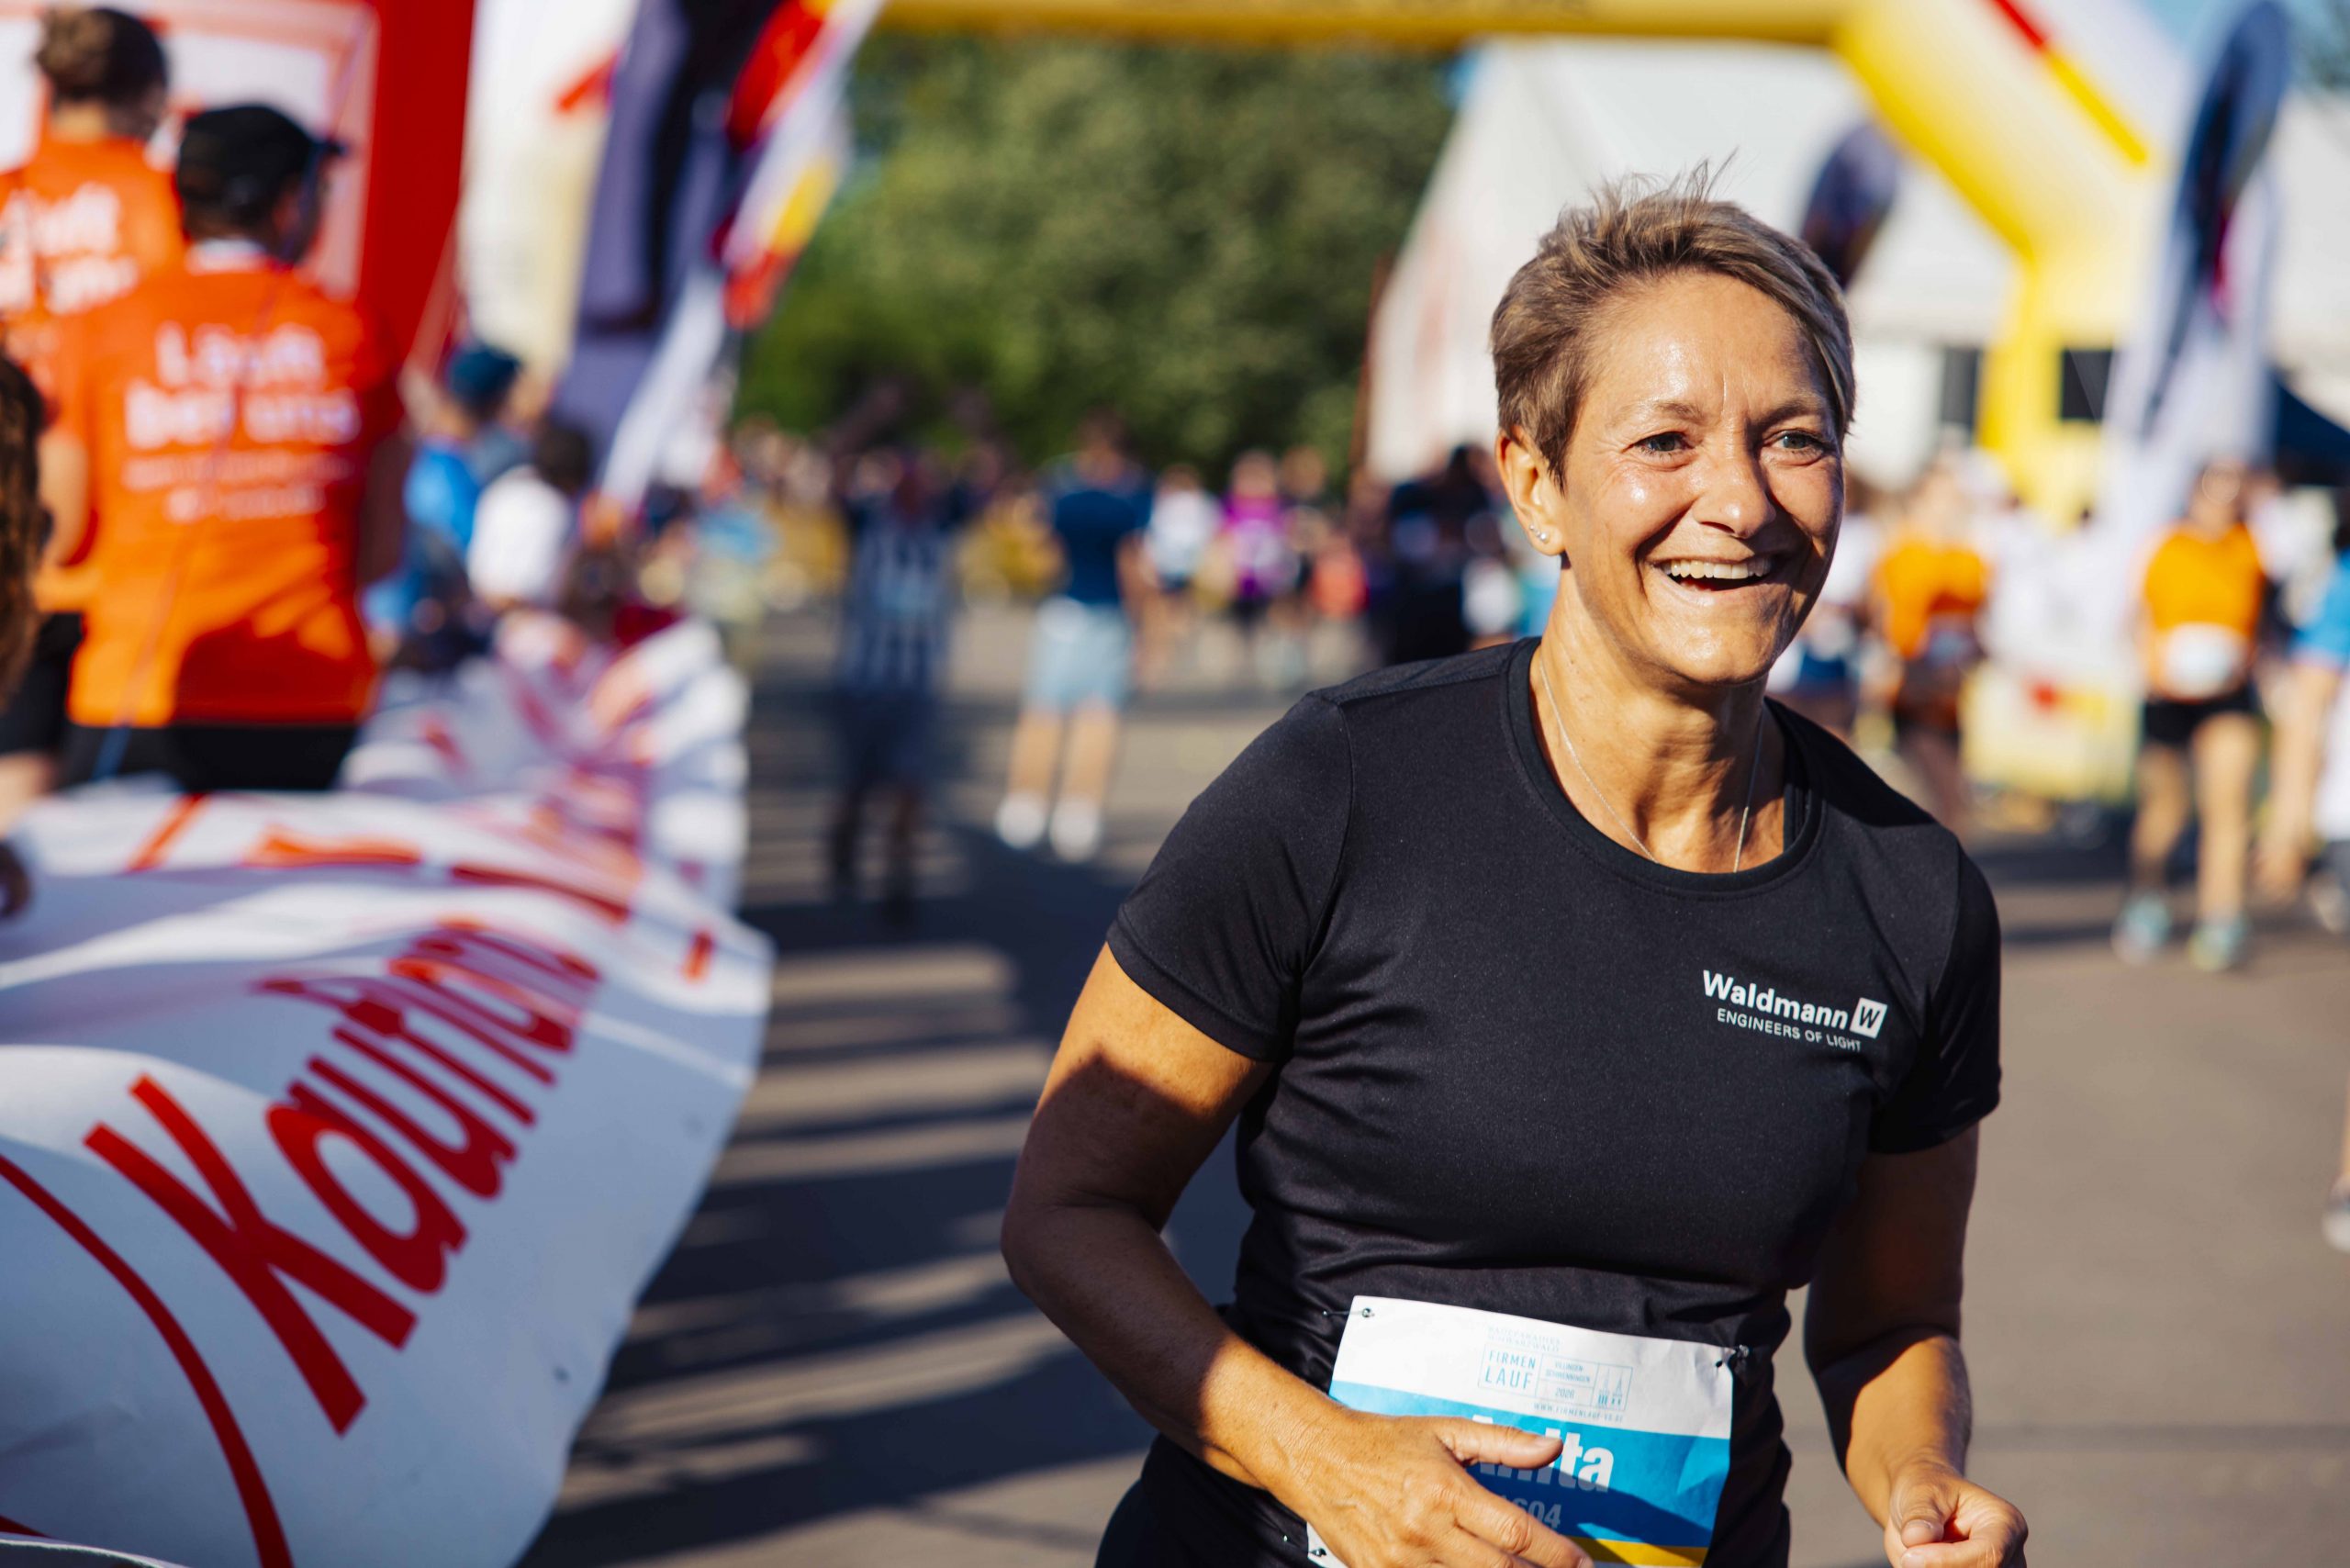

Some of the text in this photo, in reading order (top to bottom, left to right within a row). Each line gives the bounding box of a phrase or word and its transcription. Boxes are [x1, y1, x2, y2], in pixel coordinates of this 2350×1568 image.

[1703, 969, 1849, 1030] Waldmann
[1717, 1008, 1862, 1052] ENGINEERS OF LIGHT
[1489, 1350, 1537, 1369] FIRMEN
[1484, 1366, 1533, 1390] LAUF
